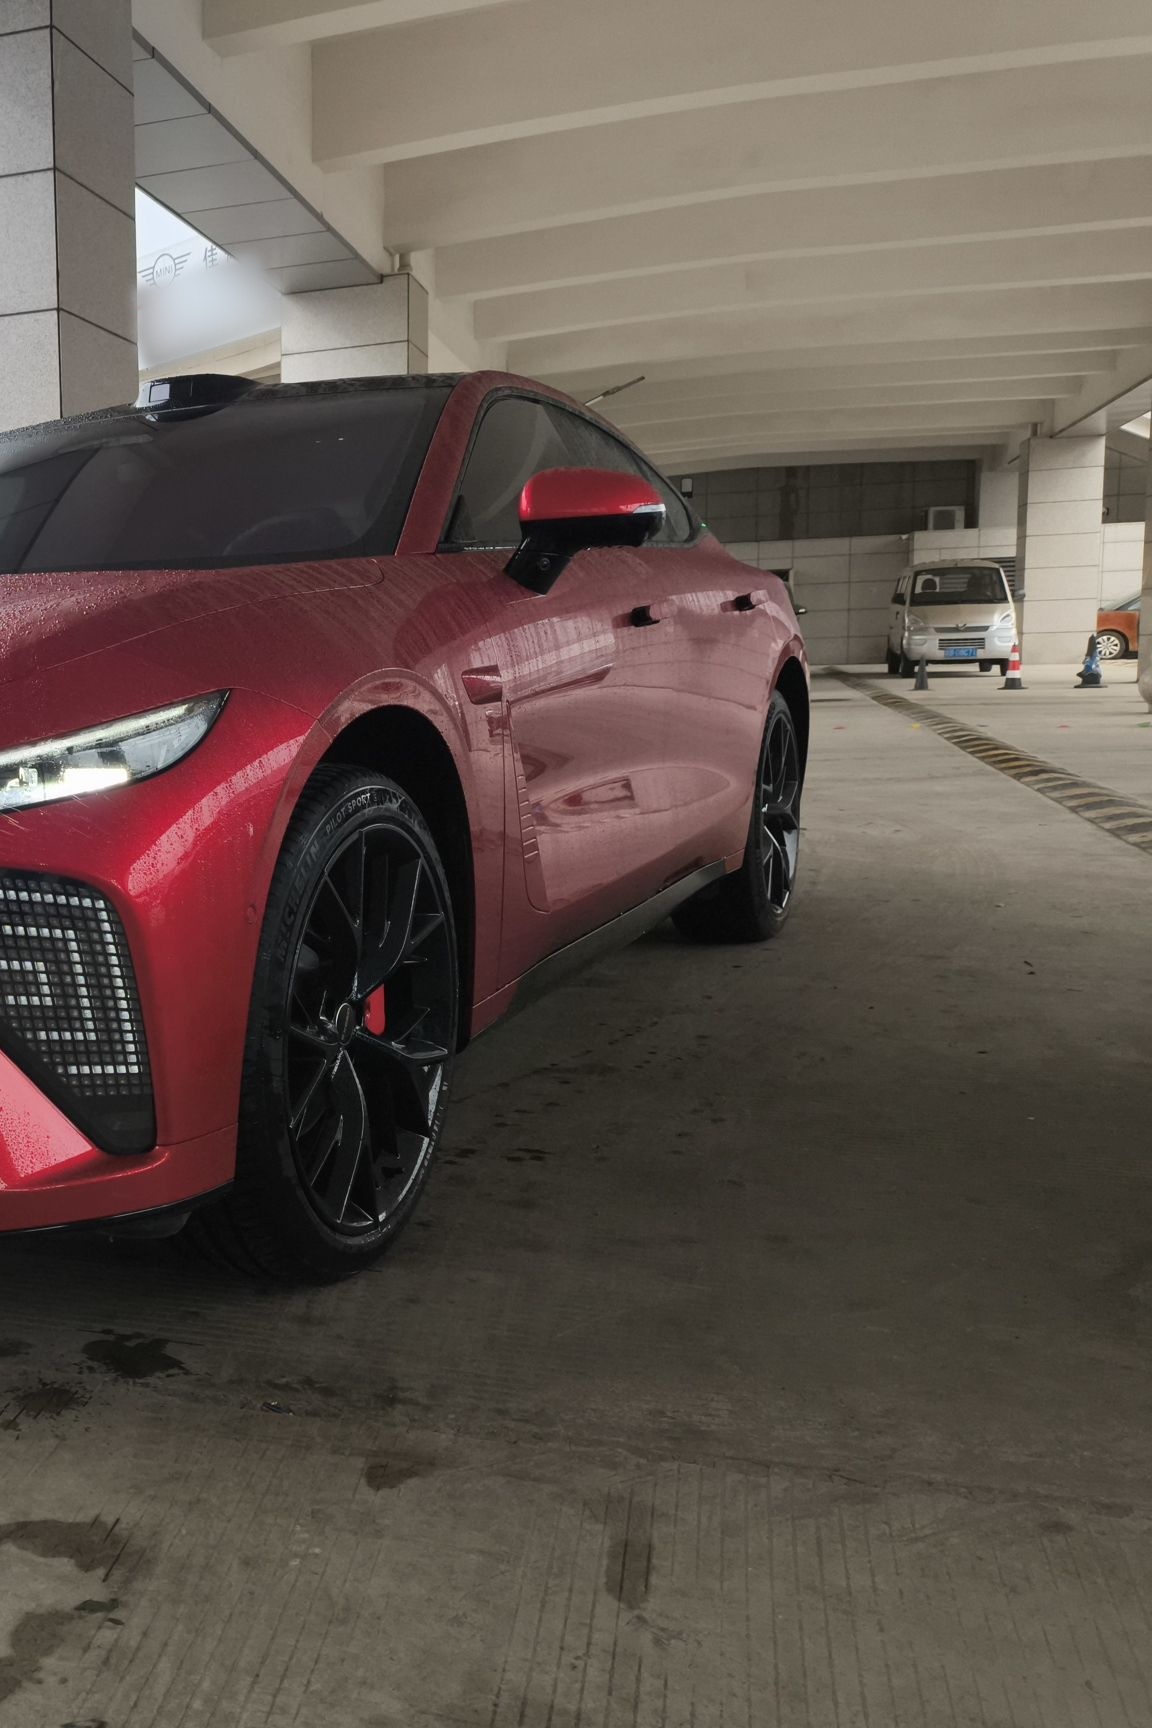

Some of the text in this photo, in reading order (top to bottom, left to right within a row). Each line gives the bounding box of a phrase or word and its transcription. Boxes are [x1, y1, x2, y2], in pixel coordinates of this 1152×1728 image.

[155, 264, 174, 279] MINI
[325, 806, 347, 836] PILOT
[347, 792, 371, 813] SPORT
